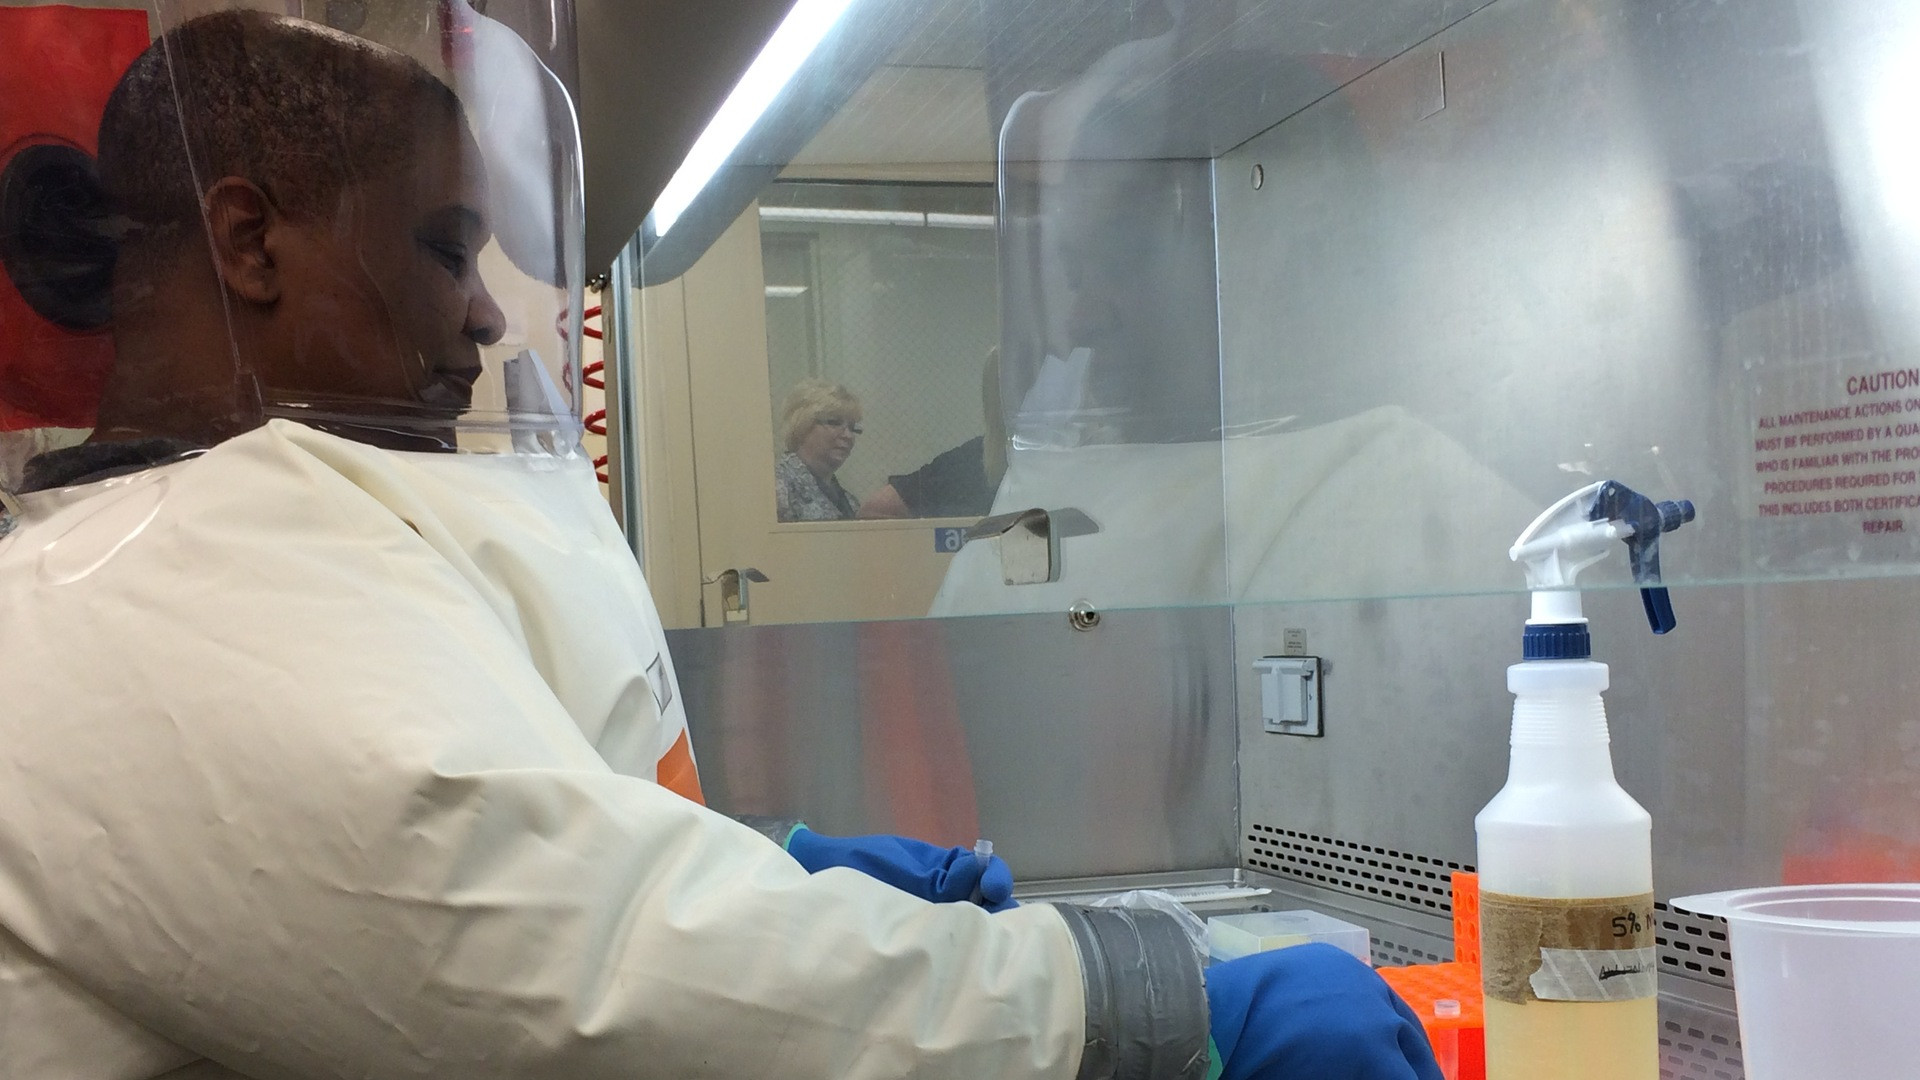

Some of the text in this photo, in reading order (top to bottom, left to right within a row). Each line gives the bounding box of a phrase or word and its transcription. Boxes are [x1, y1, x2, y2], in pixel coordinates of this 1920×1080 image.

[1846, 368, 1919, 396] CAUTION
[1758, 416, 1775, 430] ALL
[1779, 406, 1851, 427] MAINTENANCE
[1854, 400, 1902, 418] ACTIONS
[1755, 423, 1919, 452] MUST BE PERFORMED BY A QUA
[1755, 459, 1779, 473] WHO
[1781, 458, 1790, 472] IS
[1792, 454, 1839, 470] FAMILIAR
[1841, 451, 1868, 466] WITH
[1872, 449, 1891, 464] THE
[1764, 470, 1916, 494] PROCEDURES REQUIRED FOR
[1759, 503, 1779, 516] THIS
[1782, 500, 1832, 515] INCLUDES
[1834, 498, 1863, 513] BOTH
[1611, 911, 1642, 938] 5%
